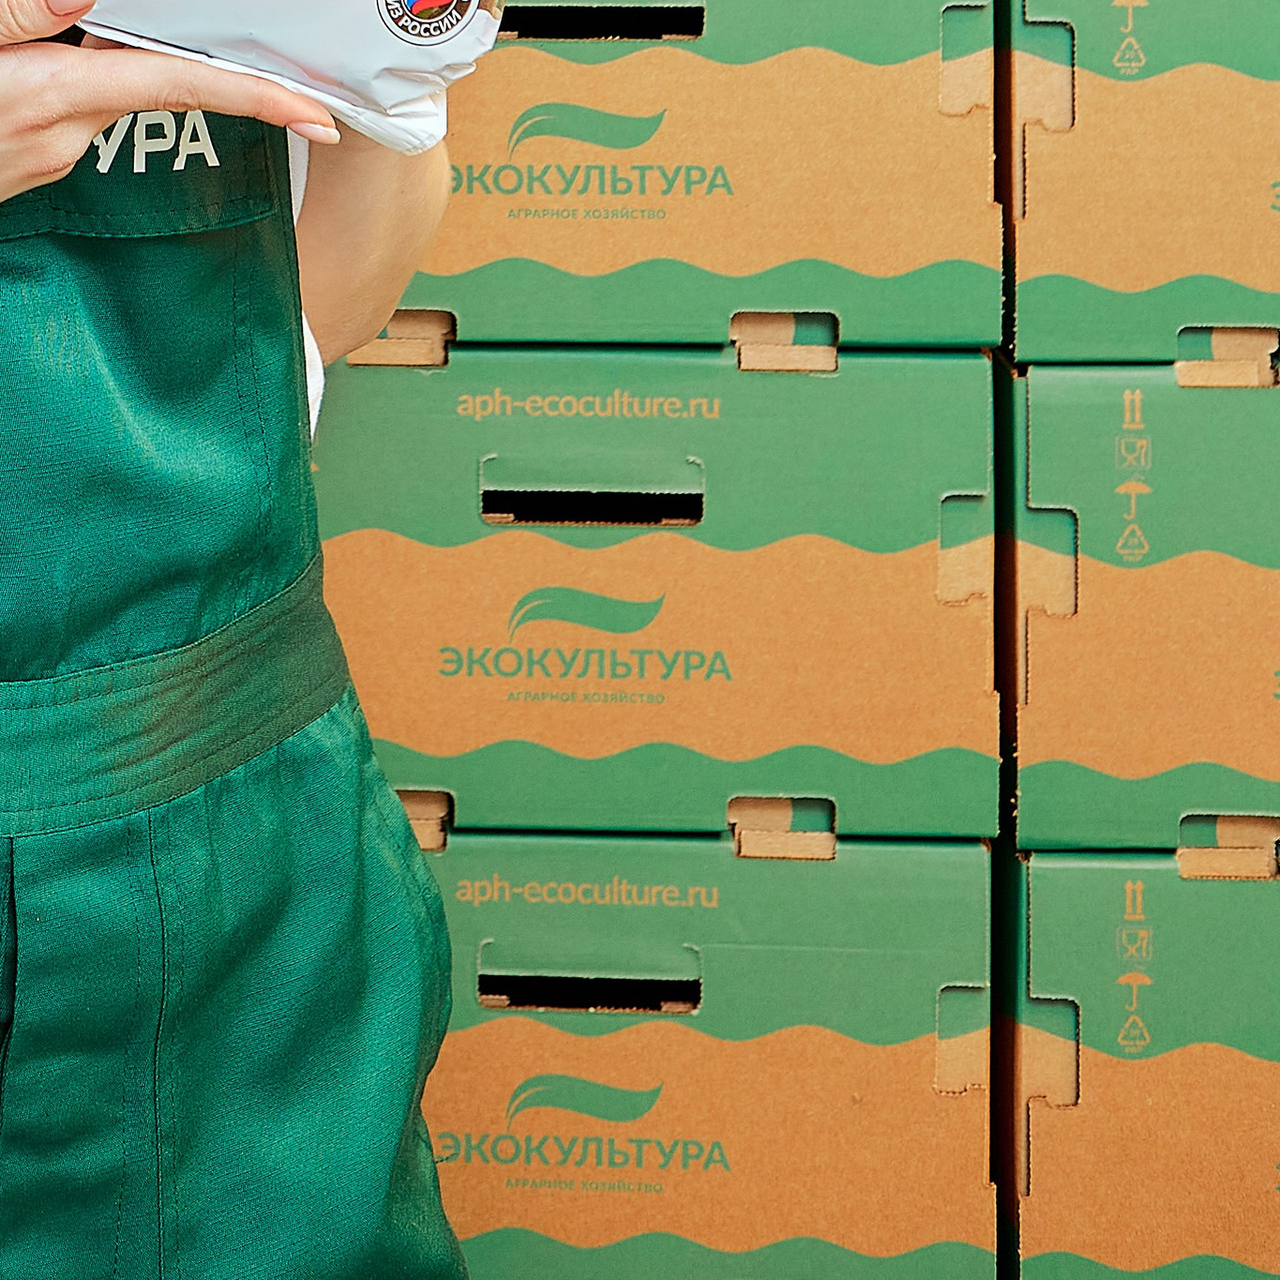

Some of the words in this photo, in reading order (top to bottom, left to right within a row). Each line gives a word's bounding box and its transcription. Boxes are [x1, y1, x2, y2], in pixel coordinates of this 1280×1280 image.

[399, 9, 462, 36] РОССИИ
[506, 209, 579, 220] АГРАРНОЕ
[582, 209, 668, 219] ХОЗЯЙСТВО
[457, 388, 720, 420] aph-ecoculture.ru
[439, 647, 733, 681] ЭКОКУЛЬТУРА
[456, 874, 718, 907] aph-ecoculture.ru
[437, 1132, 730, 1172] ЭКОКУЛЬТУРА
